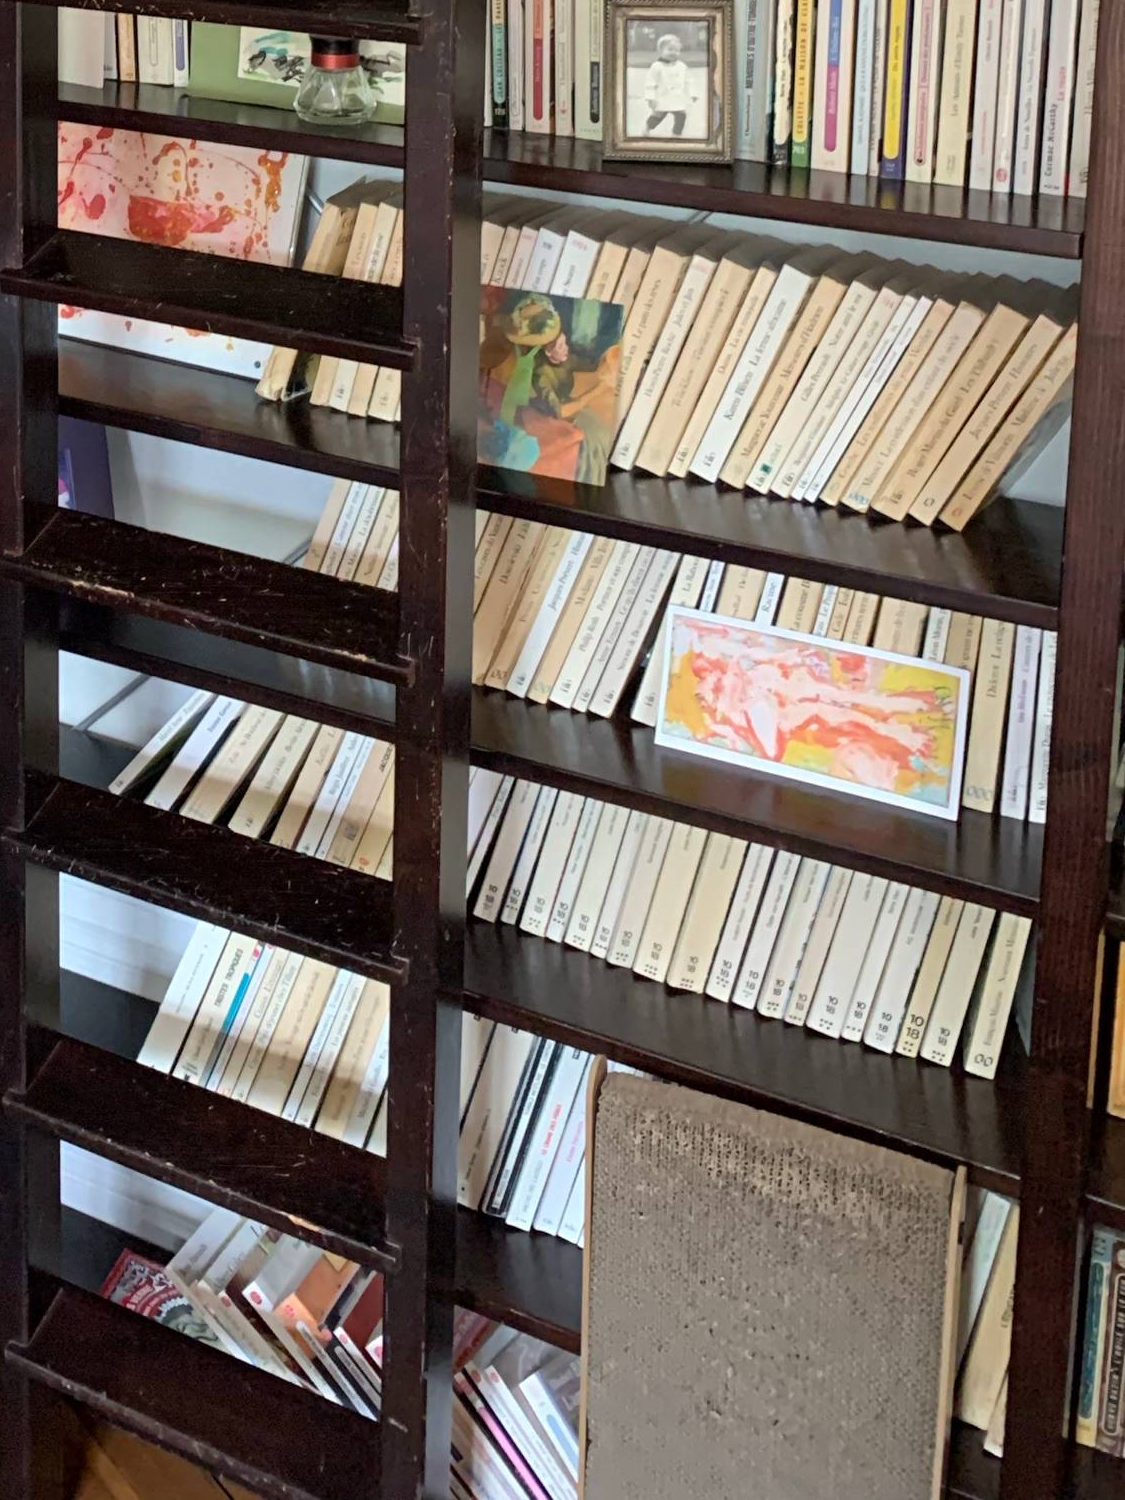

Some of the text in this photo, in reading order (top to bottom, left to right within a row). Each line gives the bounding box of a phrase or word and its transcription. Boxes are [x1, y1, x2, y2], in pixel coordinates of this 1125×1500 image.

[800, 21, 807, 32] DE
[799, 38, 807, 70] MAISON
[798, 77, 805, 85] LA
[1057, 92, 1066, 101] La
[796, 101, 804, 134] COLETTE
[1045, 104, 1059, 177] Cormac McCarthy
[722, 296, 789, 421] Karen Blixen La ferme africaine
[967, 405, 995, 439] Jacques
[546, 583, 565, 610] Jacques
[577, 631, 594, 652] Philip
[586, 614, 602, 633] Roth
[211, 947, 248, 1007] TRISTES TROPIQUES
[749, 970, 759, 979] 10
[856, 1001, 867, 1011] 10
[881, 1012, 892, 1022] 10
[910, 1014, 924, 1027] 10
[906, 1027, 920, 1039] 18
